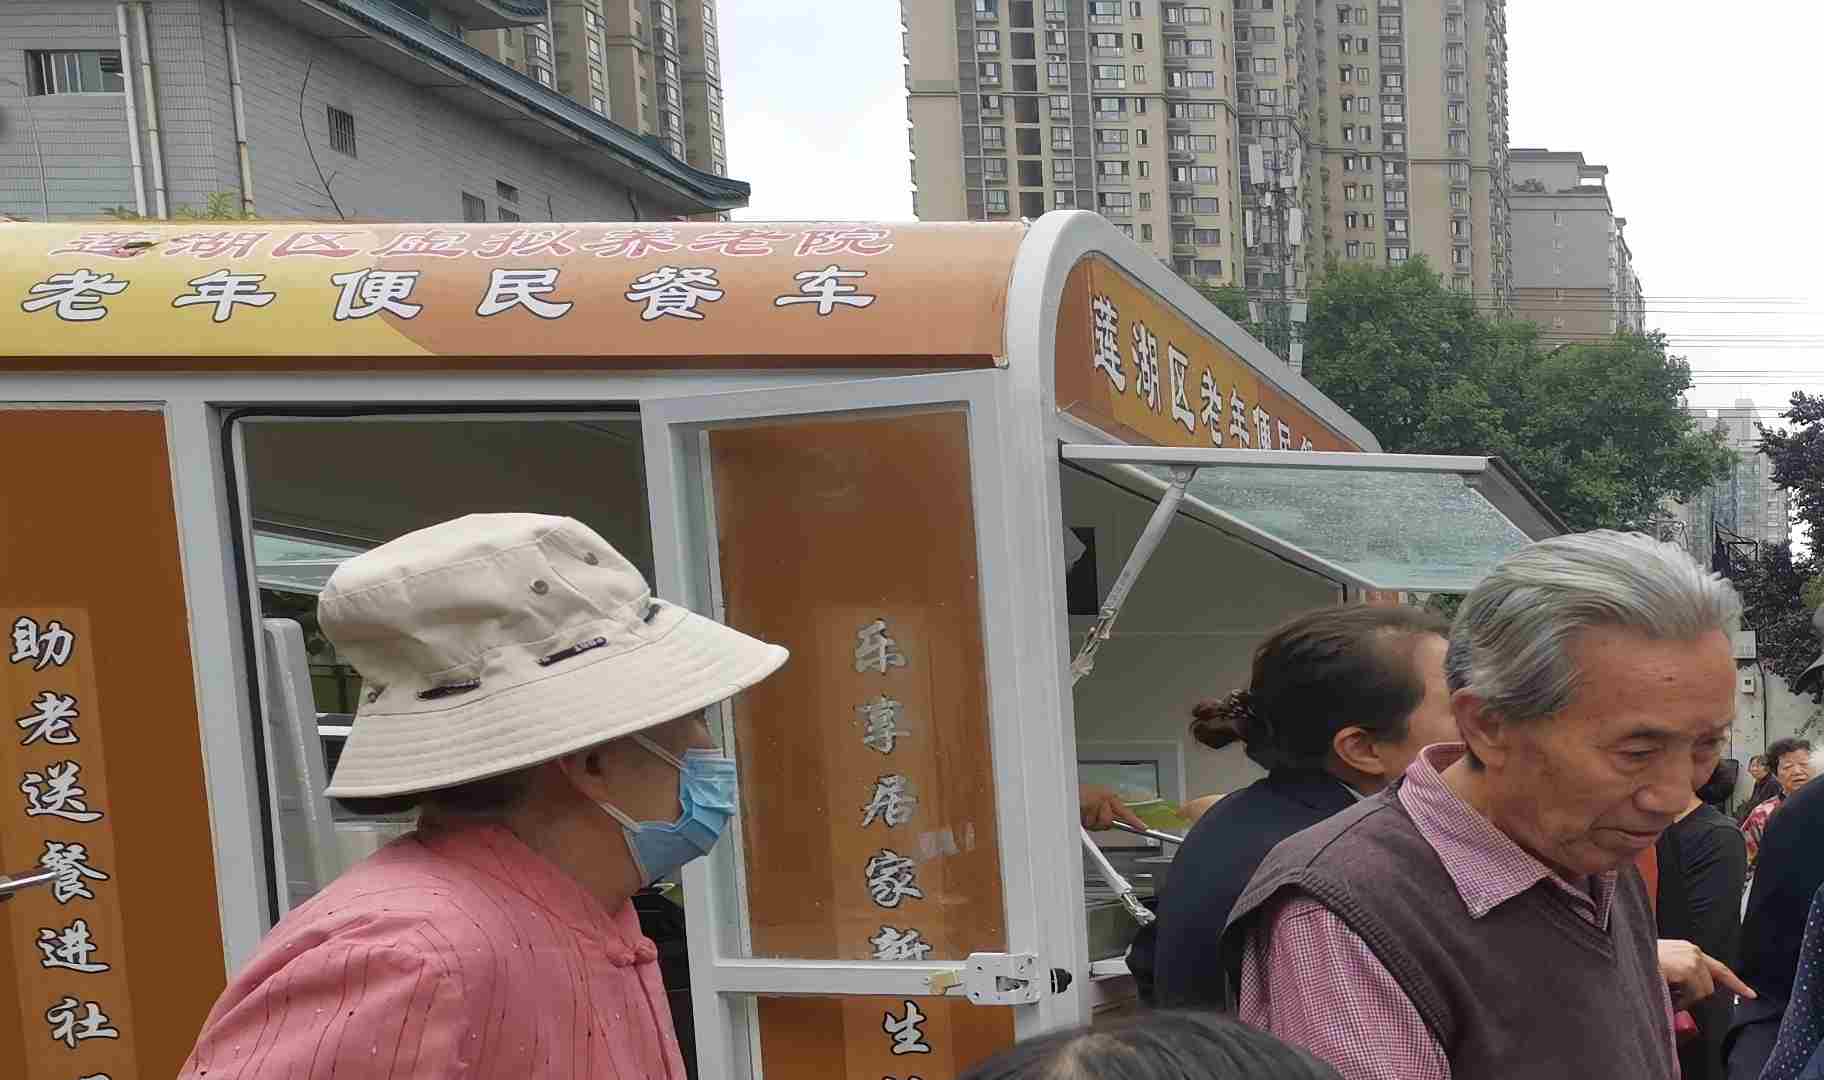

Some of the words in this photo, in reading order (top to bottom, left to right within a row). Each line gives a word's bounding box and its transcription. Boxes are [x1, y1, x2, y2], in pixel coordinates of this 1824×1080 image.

[47, 228, 896, 260] 莲湖区虚拟养老院
[20, 264, 878, 323] 老年便民餐车
